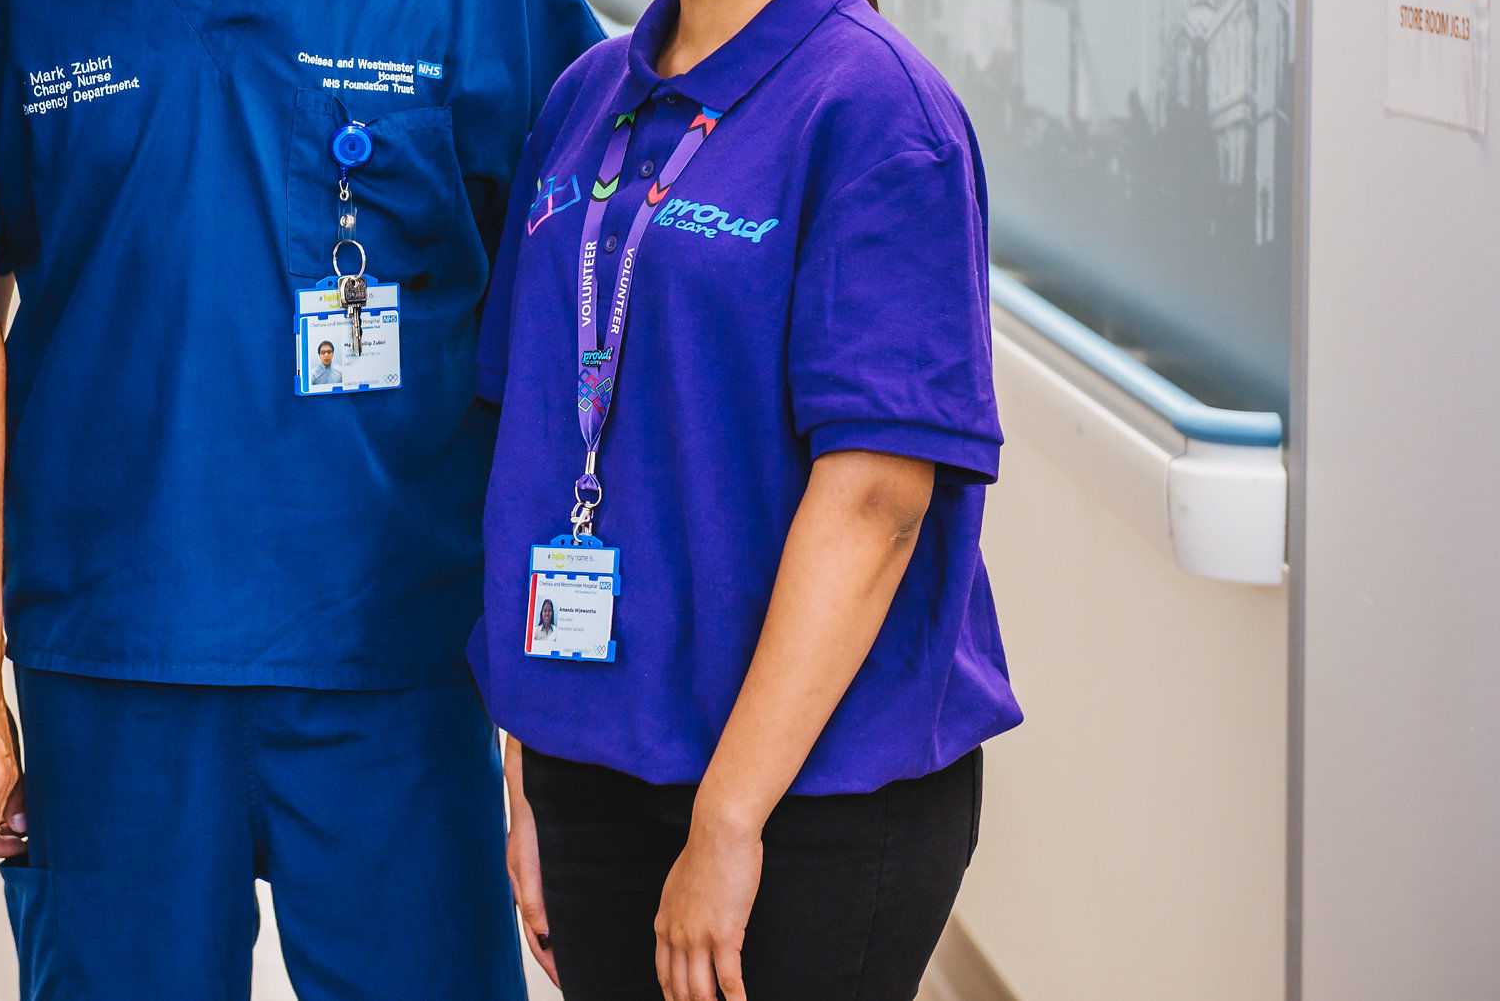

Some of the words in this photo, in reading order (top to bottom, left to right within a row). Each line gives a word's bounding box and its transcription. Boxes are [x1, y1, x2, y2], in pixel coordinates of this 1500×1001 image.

[1400, 5, 1423, 31] STORE
[1425, 9, 1449, 37] ROOM
[29, 65, 65, 86] Mark
[298, 52, 333, 68] Chelsea
[336, 58, 354, 69] and
[358, 58, 415, 74] Westminster
[418, 62, 441, 77] NHS
[33, 80, 73, 98] Charge
[77, 72, 111, 88] Nurse
[323, 78, 341, 89] NHS
[344, 79, 389, 93] Foundation
[392, 83, 415, 95] Trust
[378, 70, 414, 84] Hospital
[73, 77, 140, 103] Department
[653, 198, 780, 244] proud
[660, 215, 674, 228] to
[675, 219, 719, 239] care
[581, 241, 598, 328] VOLUNTEER
[610, 247, 636, 335] VOLUNTEER
